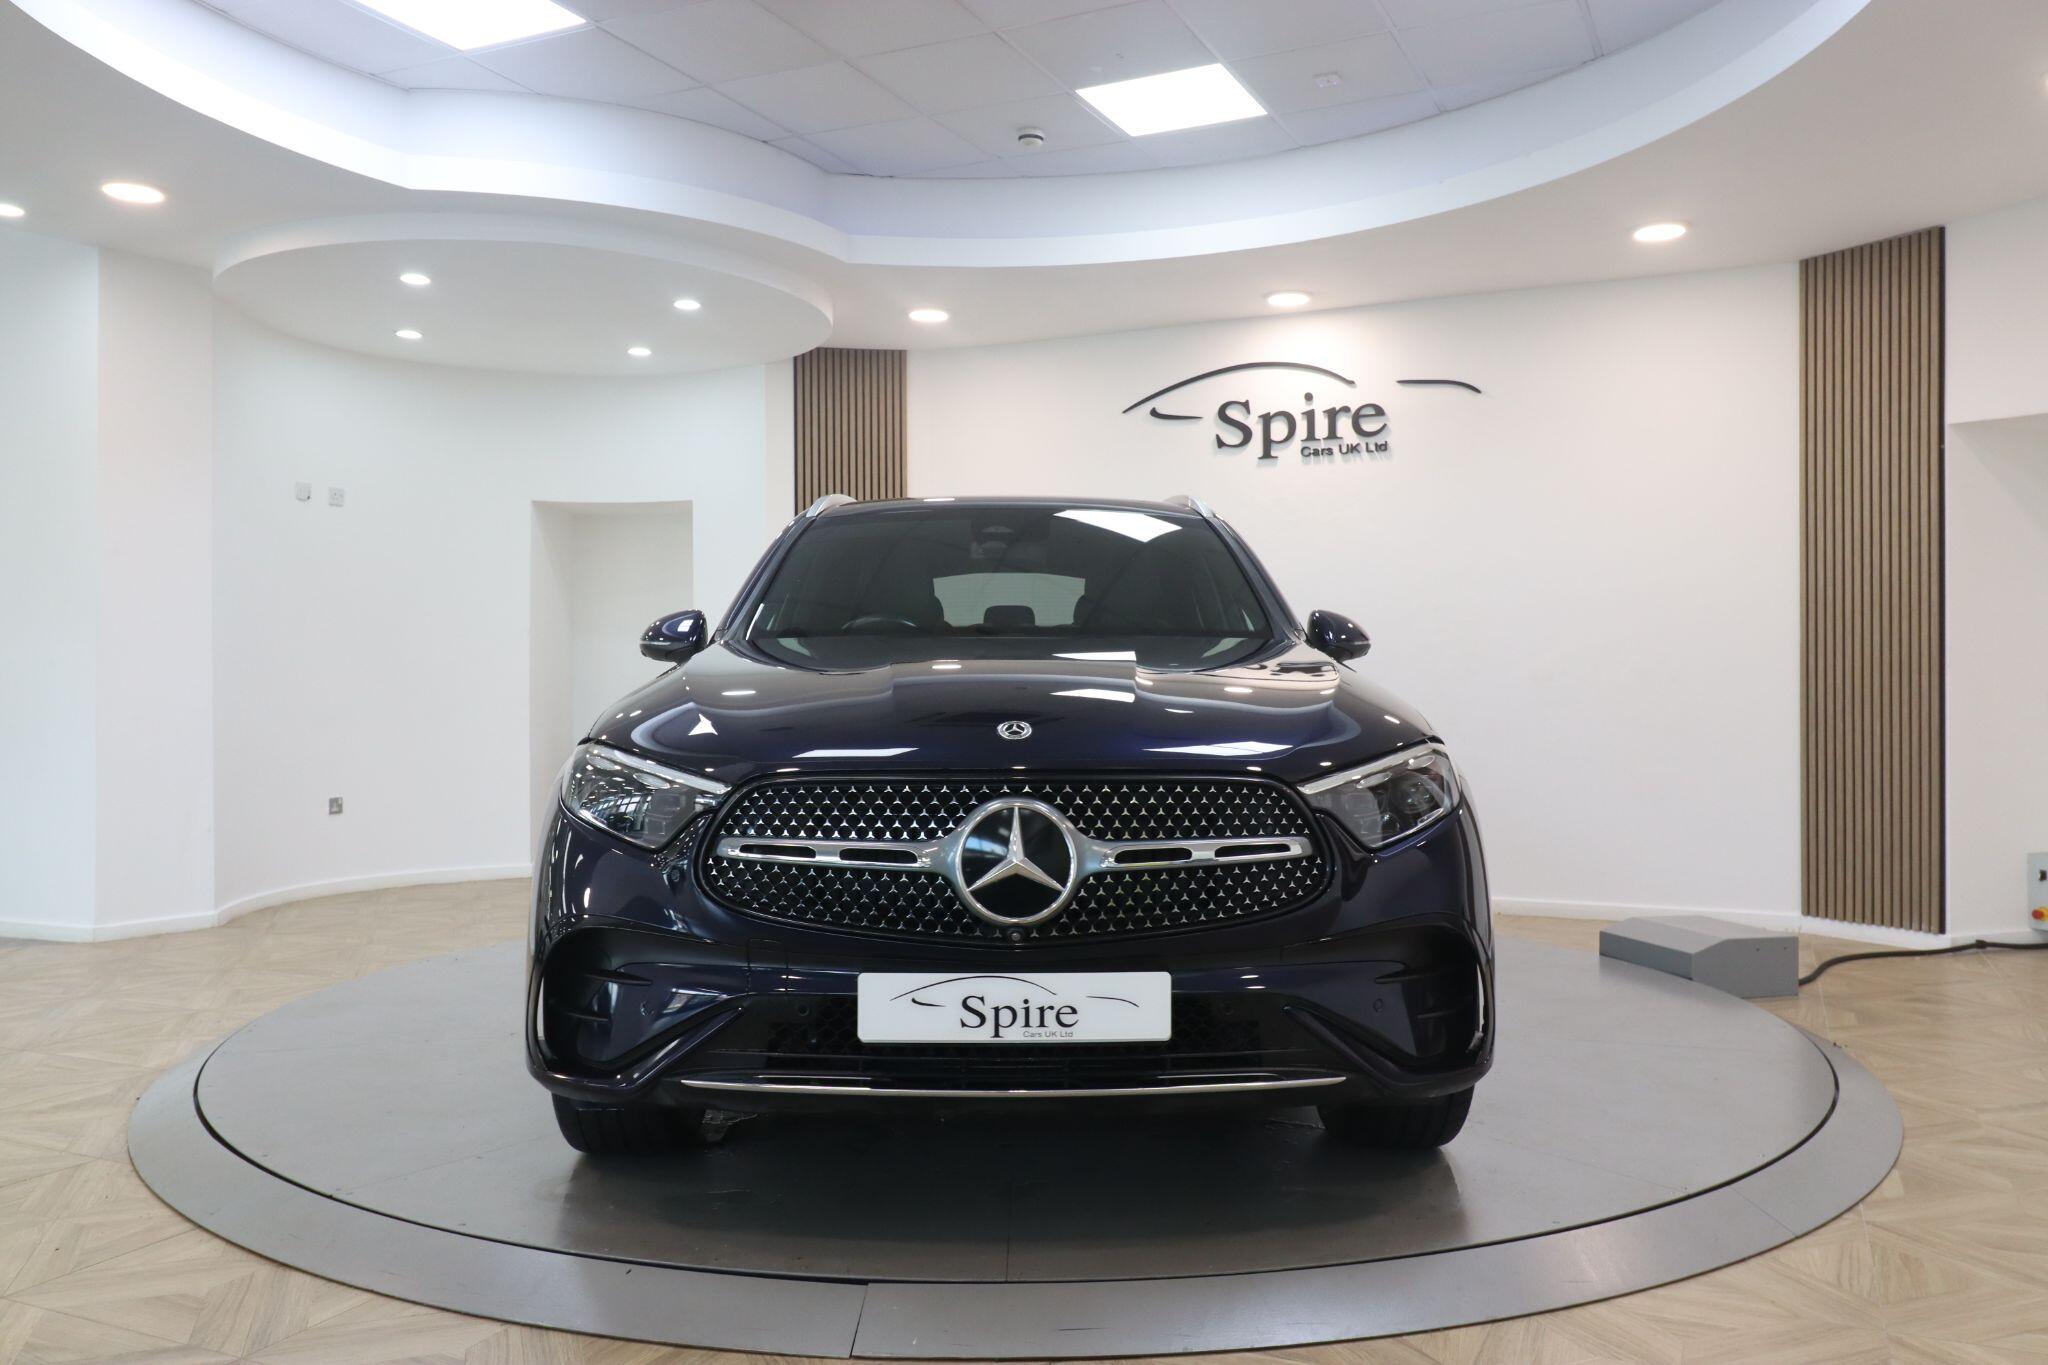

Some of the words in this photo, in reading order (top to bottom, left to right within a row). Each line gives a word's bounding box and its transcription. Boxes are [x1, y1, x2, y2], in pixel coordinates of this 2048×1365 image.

[1216, 392, 1387, 460] Spire
[1300, 446, 1334, 457] Cars
[1339, 442, 1361, 455] UK
[1365, 440, 1388, 453] Ltd
[960, 995, 1079, 1038] Spire
[1022, 1030, 1043, 1038] Cars
